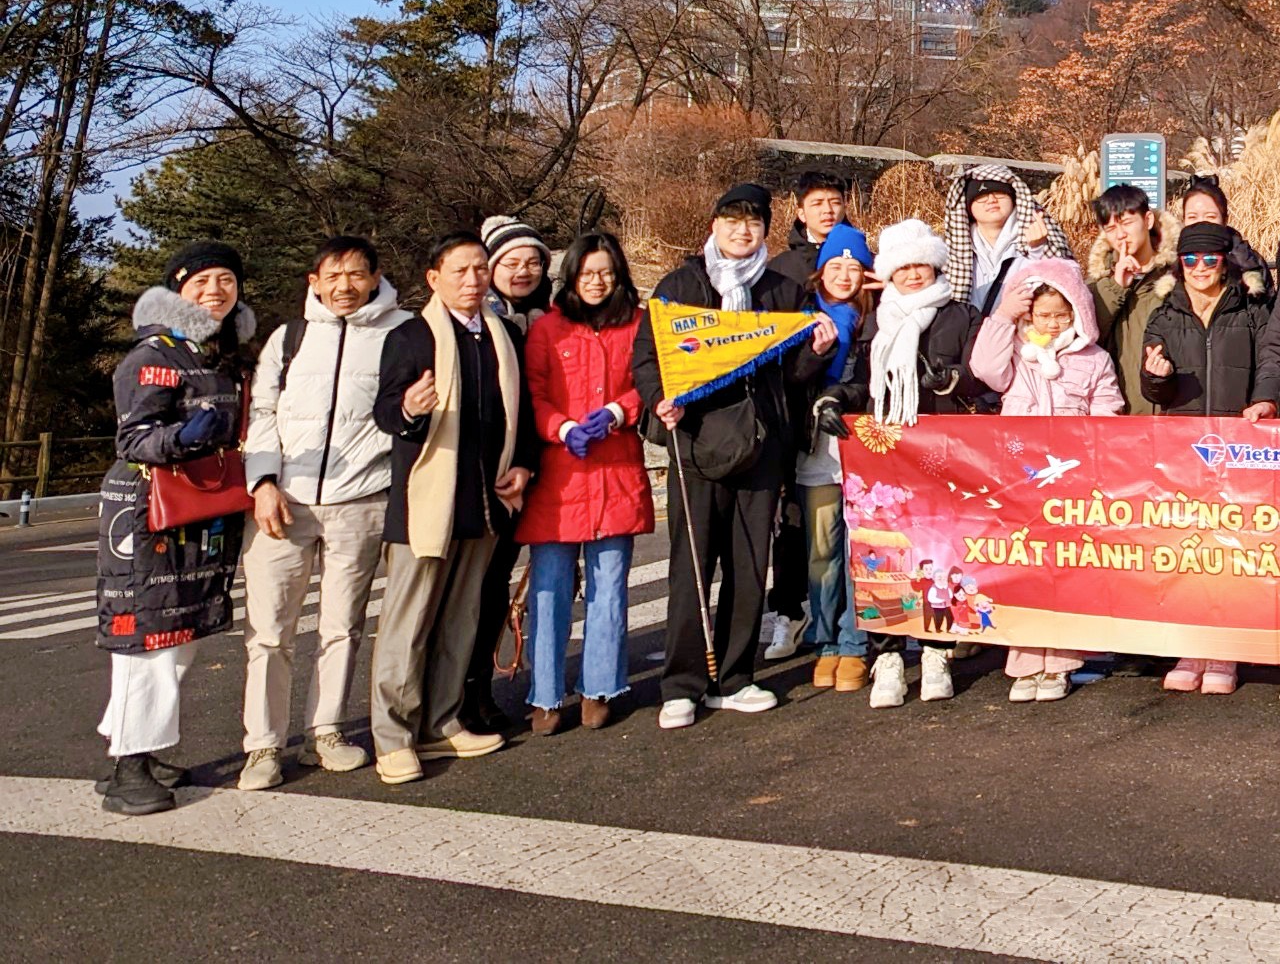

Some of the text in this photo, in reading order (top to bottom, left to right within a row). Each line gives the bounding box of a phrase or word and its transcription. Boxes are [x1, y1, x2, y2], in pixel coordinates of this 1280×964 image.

[842, 248, 853, 259] R
[674, 314, 715, 332] HAN 76
[704, 325, 776, 348] Vietravel
[1042, 489, 1134, 526] CHÀO
[1142, 491, 1244, 531] MỪNG
[963, 526, 1048, 567] XUẤT
[1055, 533, 1145, 571] HÀNH
[1151, 533, 1225, 575] ĐẦU
